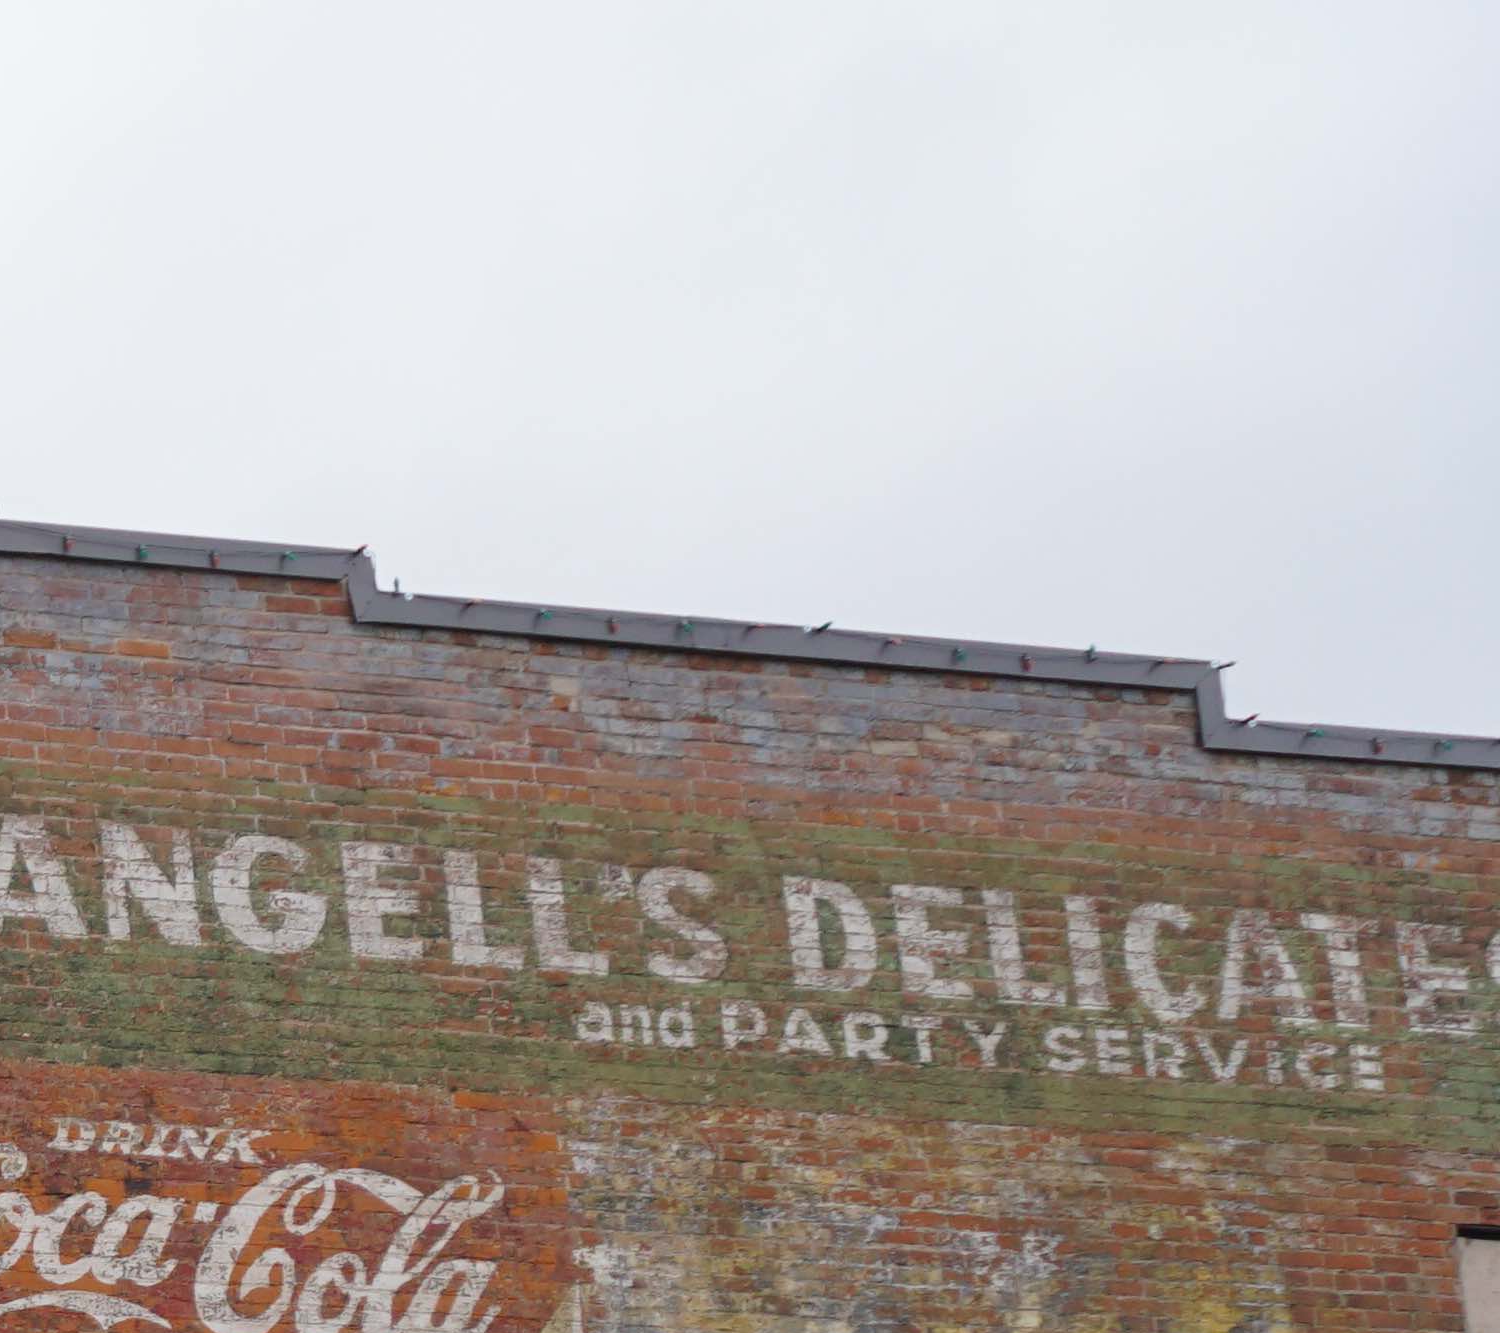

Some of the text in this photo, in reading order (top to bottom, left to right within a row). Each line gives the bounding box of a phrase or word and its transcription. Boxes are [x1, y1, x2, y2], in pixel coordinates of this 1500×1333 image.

[782, 872, 1500, 1037] DELICATE
[573, 1000, 1385, 1092] and PARTY SERVICE
[46, 1114, 276, 1166] DRINK
